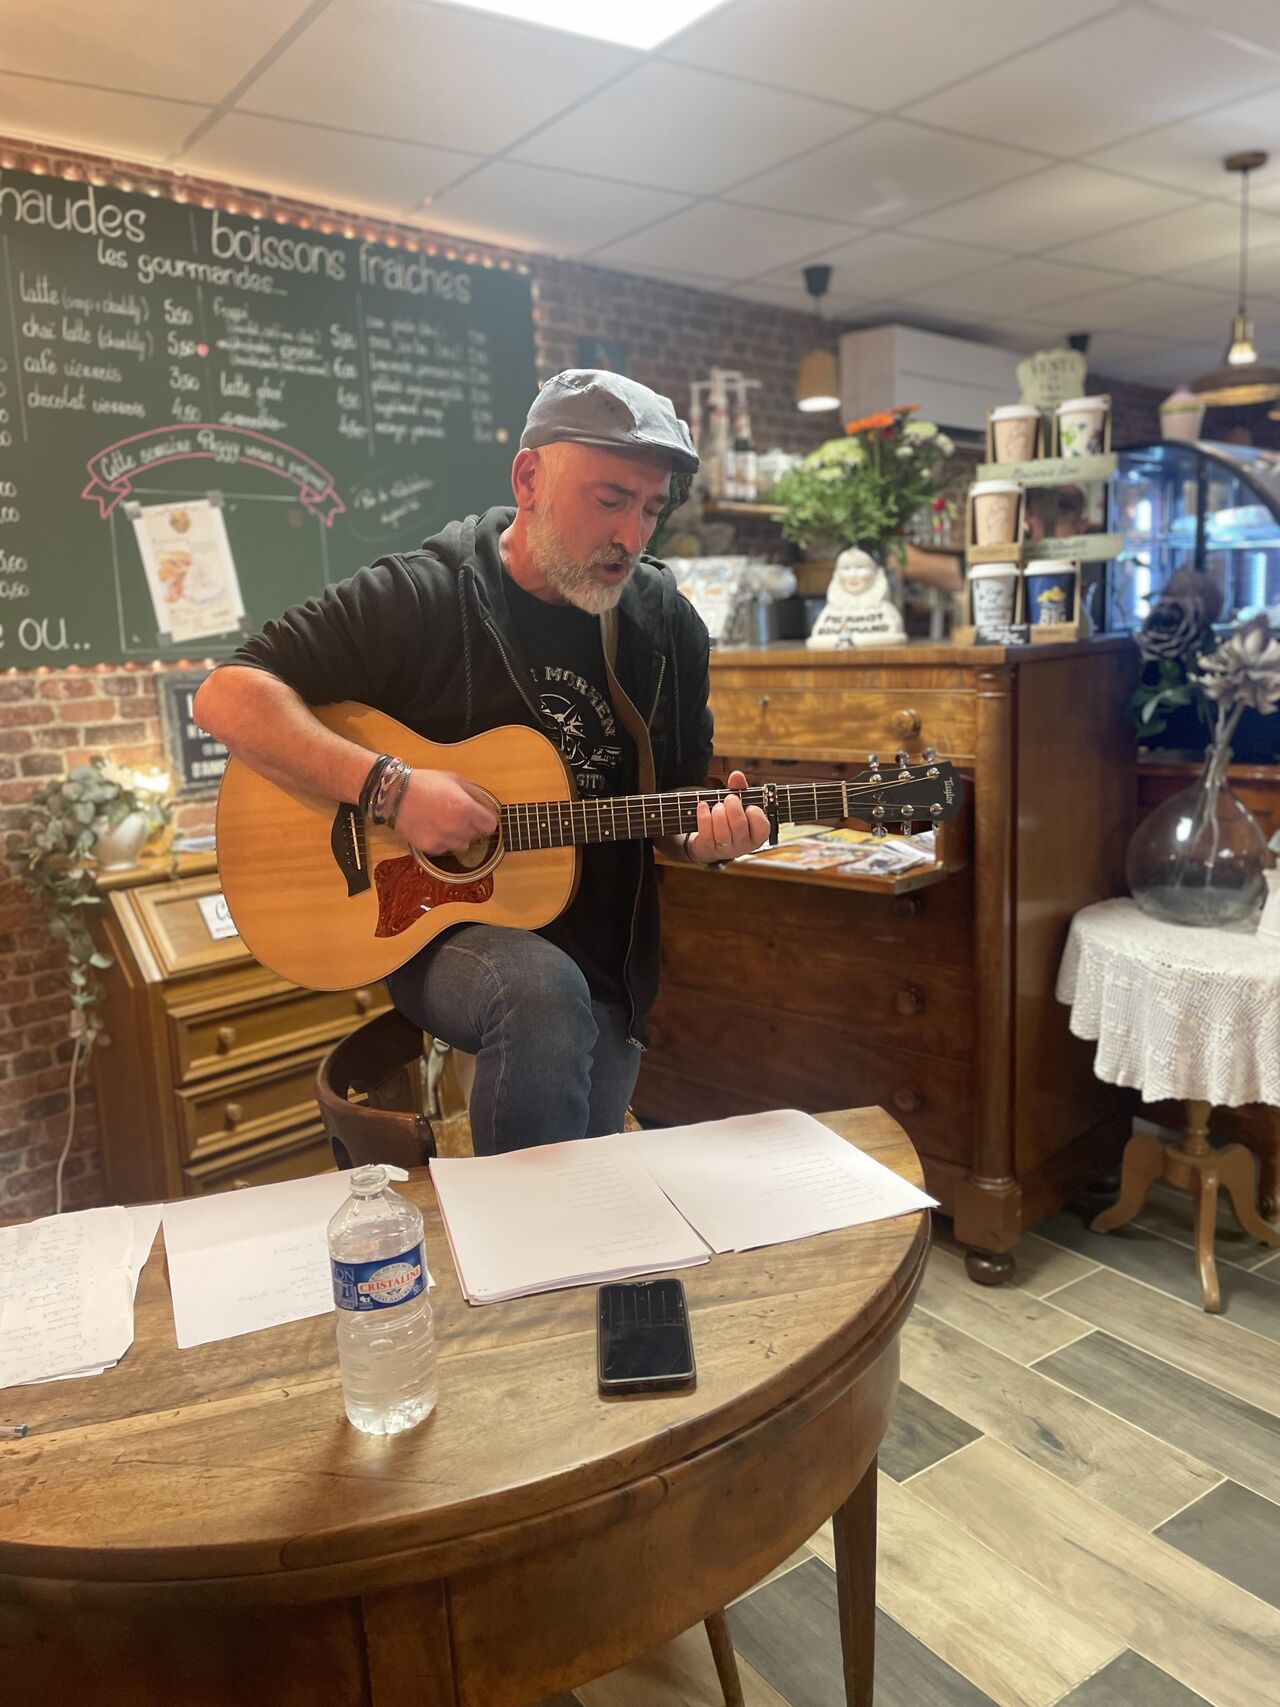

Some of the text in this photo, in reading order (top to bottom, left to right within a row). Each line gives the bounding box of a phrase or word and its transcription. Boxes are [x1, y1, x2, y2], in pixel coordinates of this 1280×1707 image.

[97, 239, 128, 268] les
[211, 210, 346, 281] boissons
[943, 776, 957, 805] Taylor
